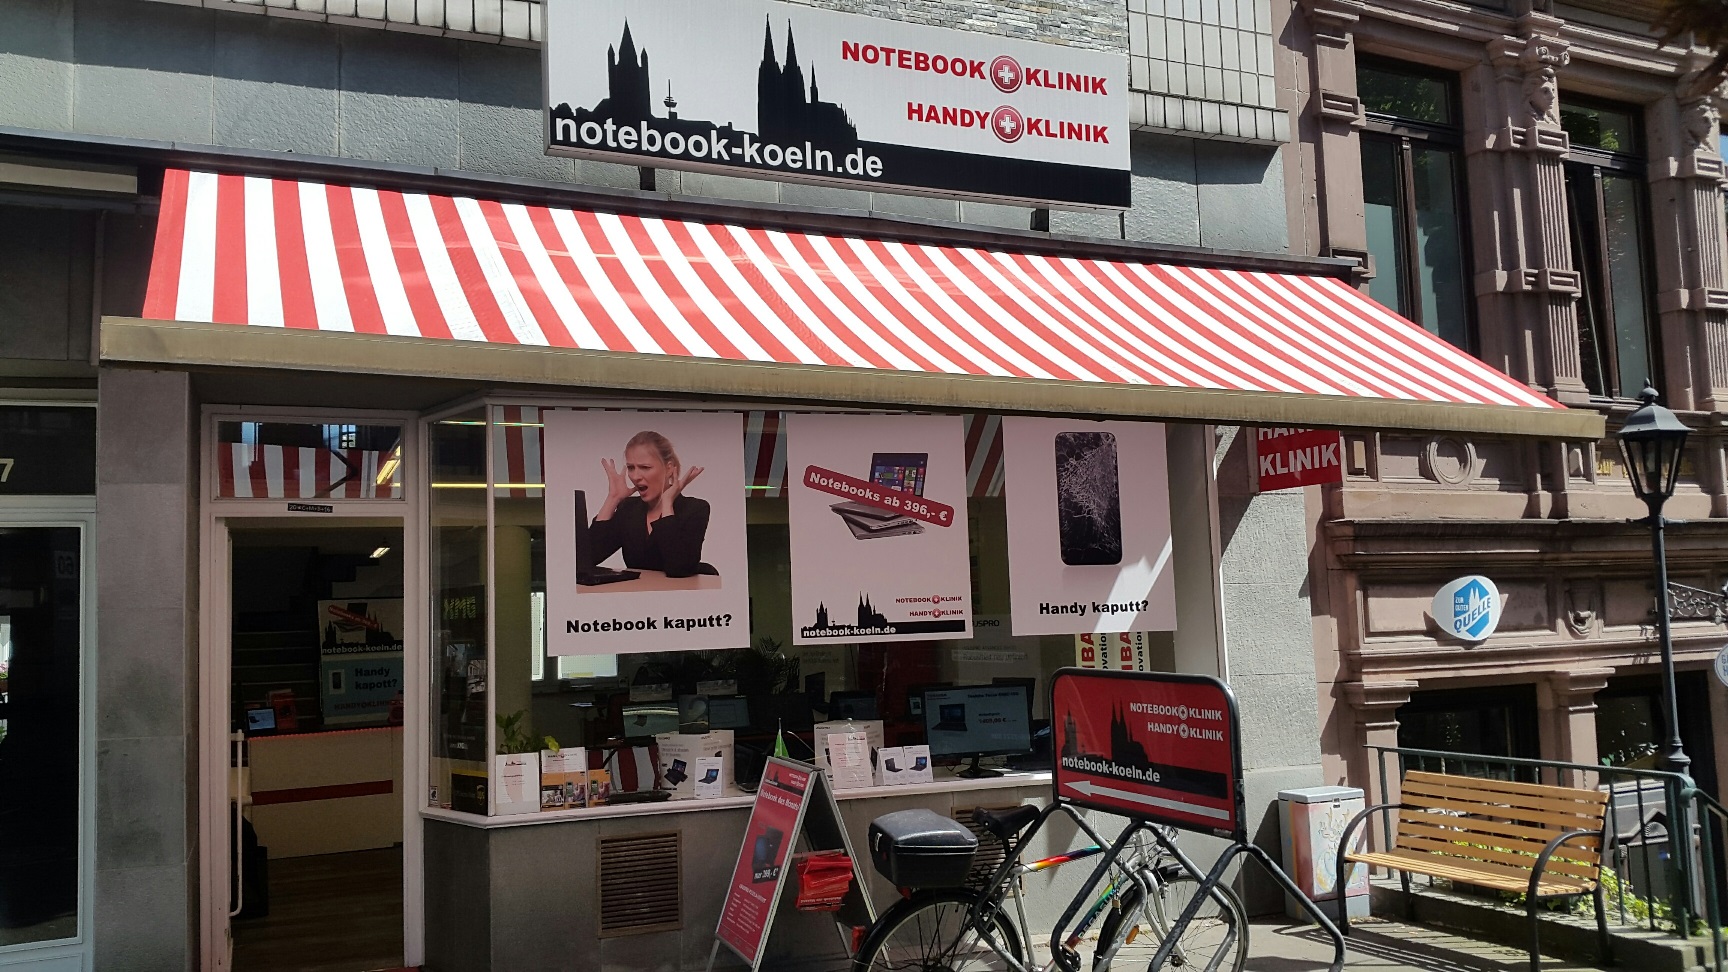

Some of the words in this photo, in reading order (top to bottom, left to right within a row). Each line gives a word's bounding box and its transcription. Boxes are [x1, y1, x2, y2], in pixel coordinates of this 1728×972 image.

[841, 40, 987, 80] NOTEBOOK
[1025, 67, 1108, 96] KLINIK
[907, 101, 990, 130] HANDY
[1026, 117, 1110, 144] KLINIK
[555, 116, 884, 178] notebook-koeln.de
[1259, 442, 1339, 477] KLINIK
[809, 471, 881, 502] Notebooks
[884, 495, 900, 507] ab
[903, 499, 936, 519] 396,-
[938, 510, 948, 521] €
[895, 596, 932, 604] NOTEBOOK
[1039, 601, 1087, 617] Handy
[1091, 600, 1149, 616] kaputt?
[566, 617, 658, 634] Notebook
[663, 613, 732, 632] kaputt?
[1453, 597, 1492, 634] QUELLE
[803, 625, 897, 638] notebook-koeln.de
[322, 643, 403, 654] notebook-koeln.de
[354, 667, 391, 678] Handy
[354, 679, 398, 691] kapott?
[1129, 702, 1179, 717] NOTEBOOK
[1189, 707, 1223, 721] KLINIK
[1147, 721, 1178, 735] HANDY
[1189, 727, 1224, 742] KLINIK
[1062, 756, 1160, 783] notebook-koeln.de
